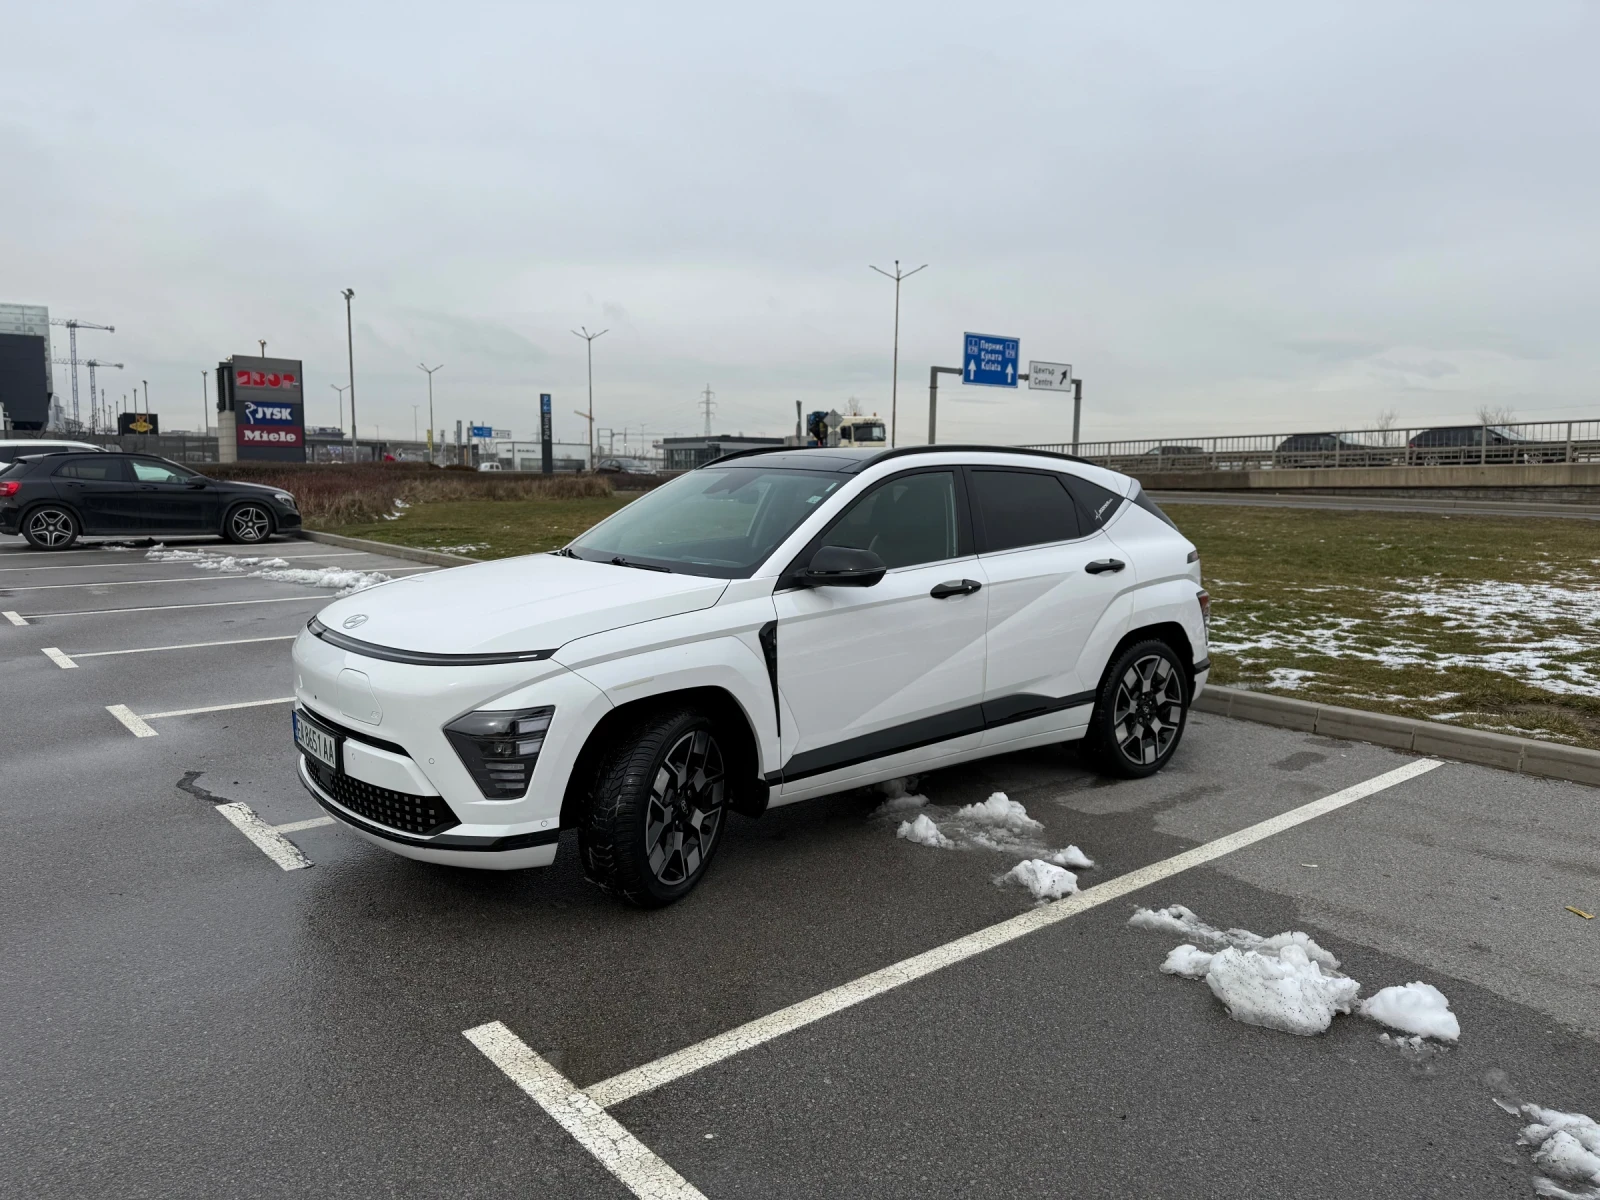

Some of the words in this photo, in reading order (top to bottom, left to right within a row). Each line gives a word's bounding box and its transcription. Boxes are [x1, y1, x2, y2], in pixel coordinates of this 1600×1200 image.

[980, 340, 1004, 351] Перник
[981, 351, 1002, 361] Кулата
[981, 361, 1001, 371] Kulata
[1033, 365, 1055, 376] Център
[1034, 378, 1053, 387] Centre
[255, 407, 292, 420] JYSK
[243, 430, 297, 442] Miele
[323, 736, 335, 765] AA
